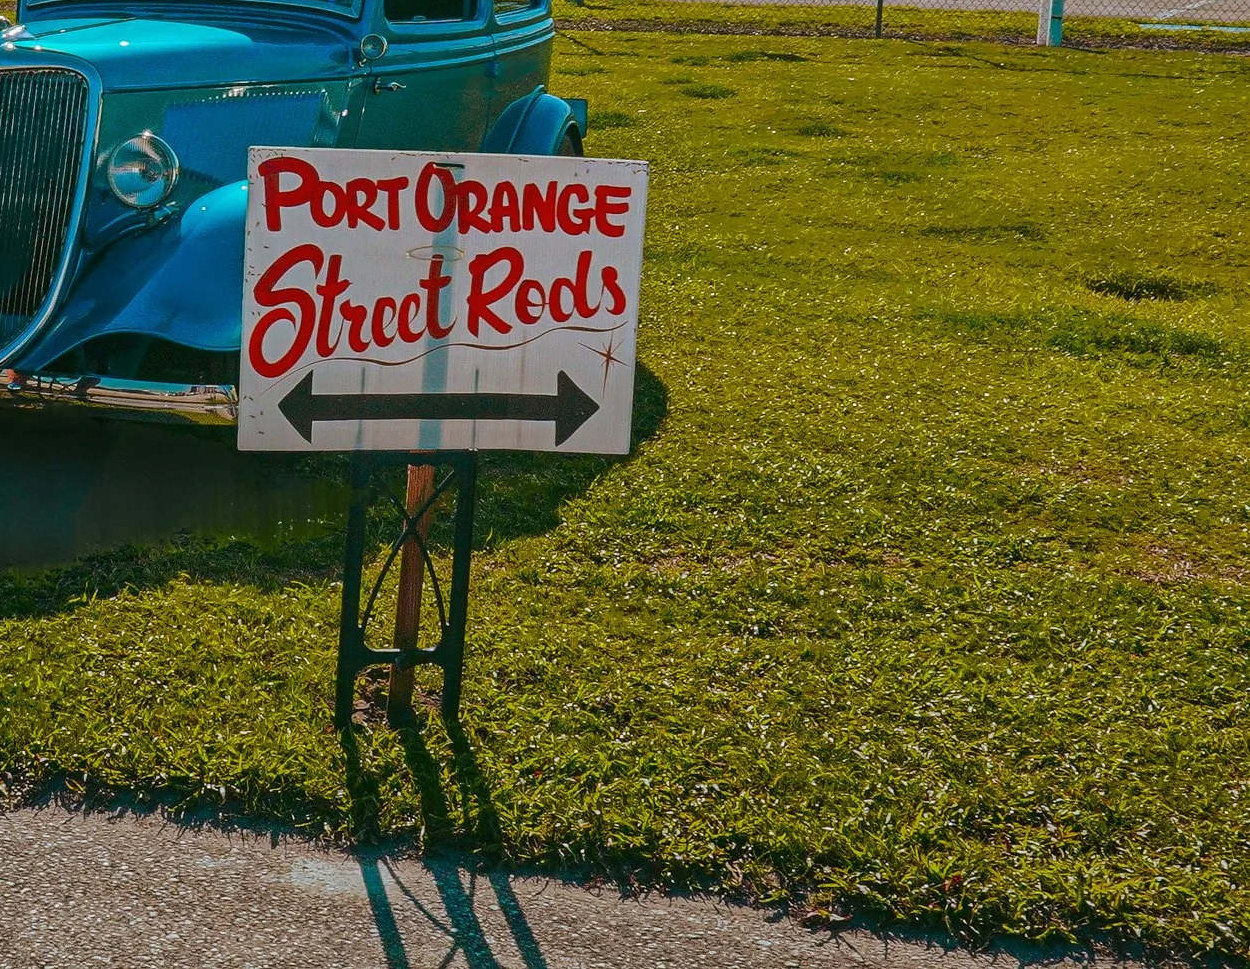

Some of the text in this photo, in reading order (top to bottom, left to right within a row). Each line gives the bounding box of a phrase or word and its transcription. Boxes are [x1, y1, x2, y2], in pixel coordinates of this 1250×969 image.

[258, 157, 632, 238] PORT ORANGE
[248, 244, 627, 379] Street Rods
